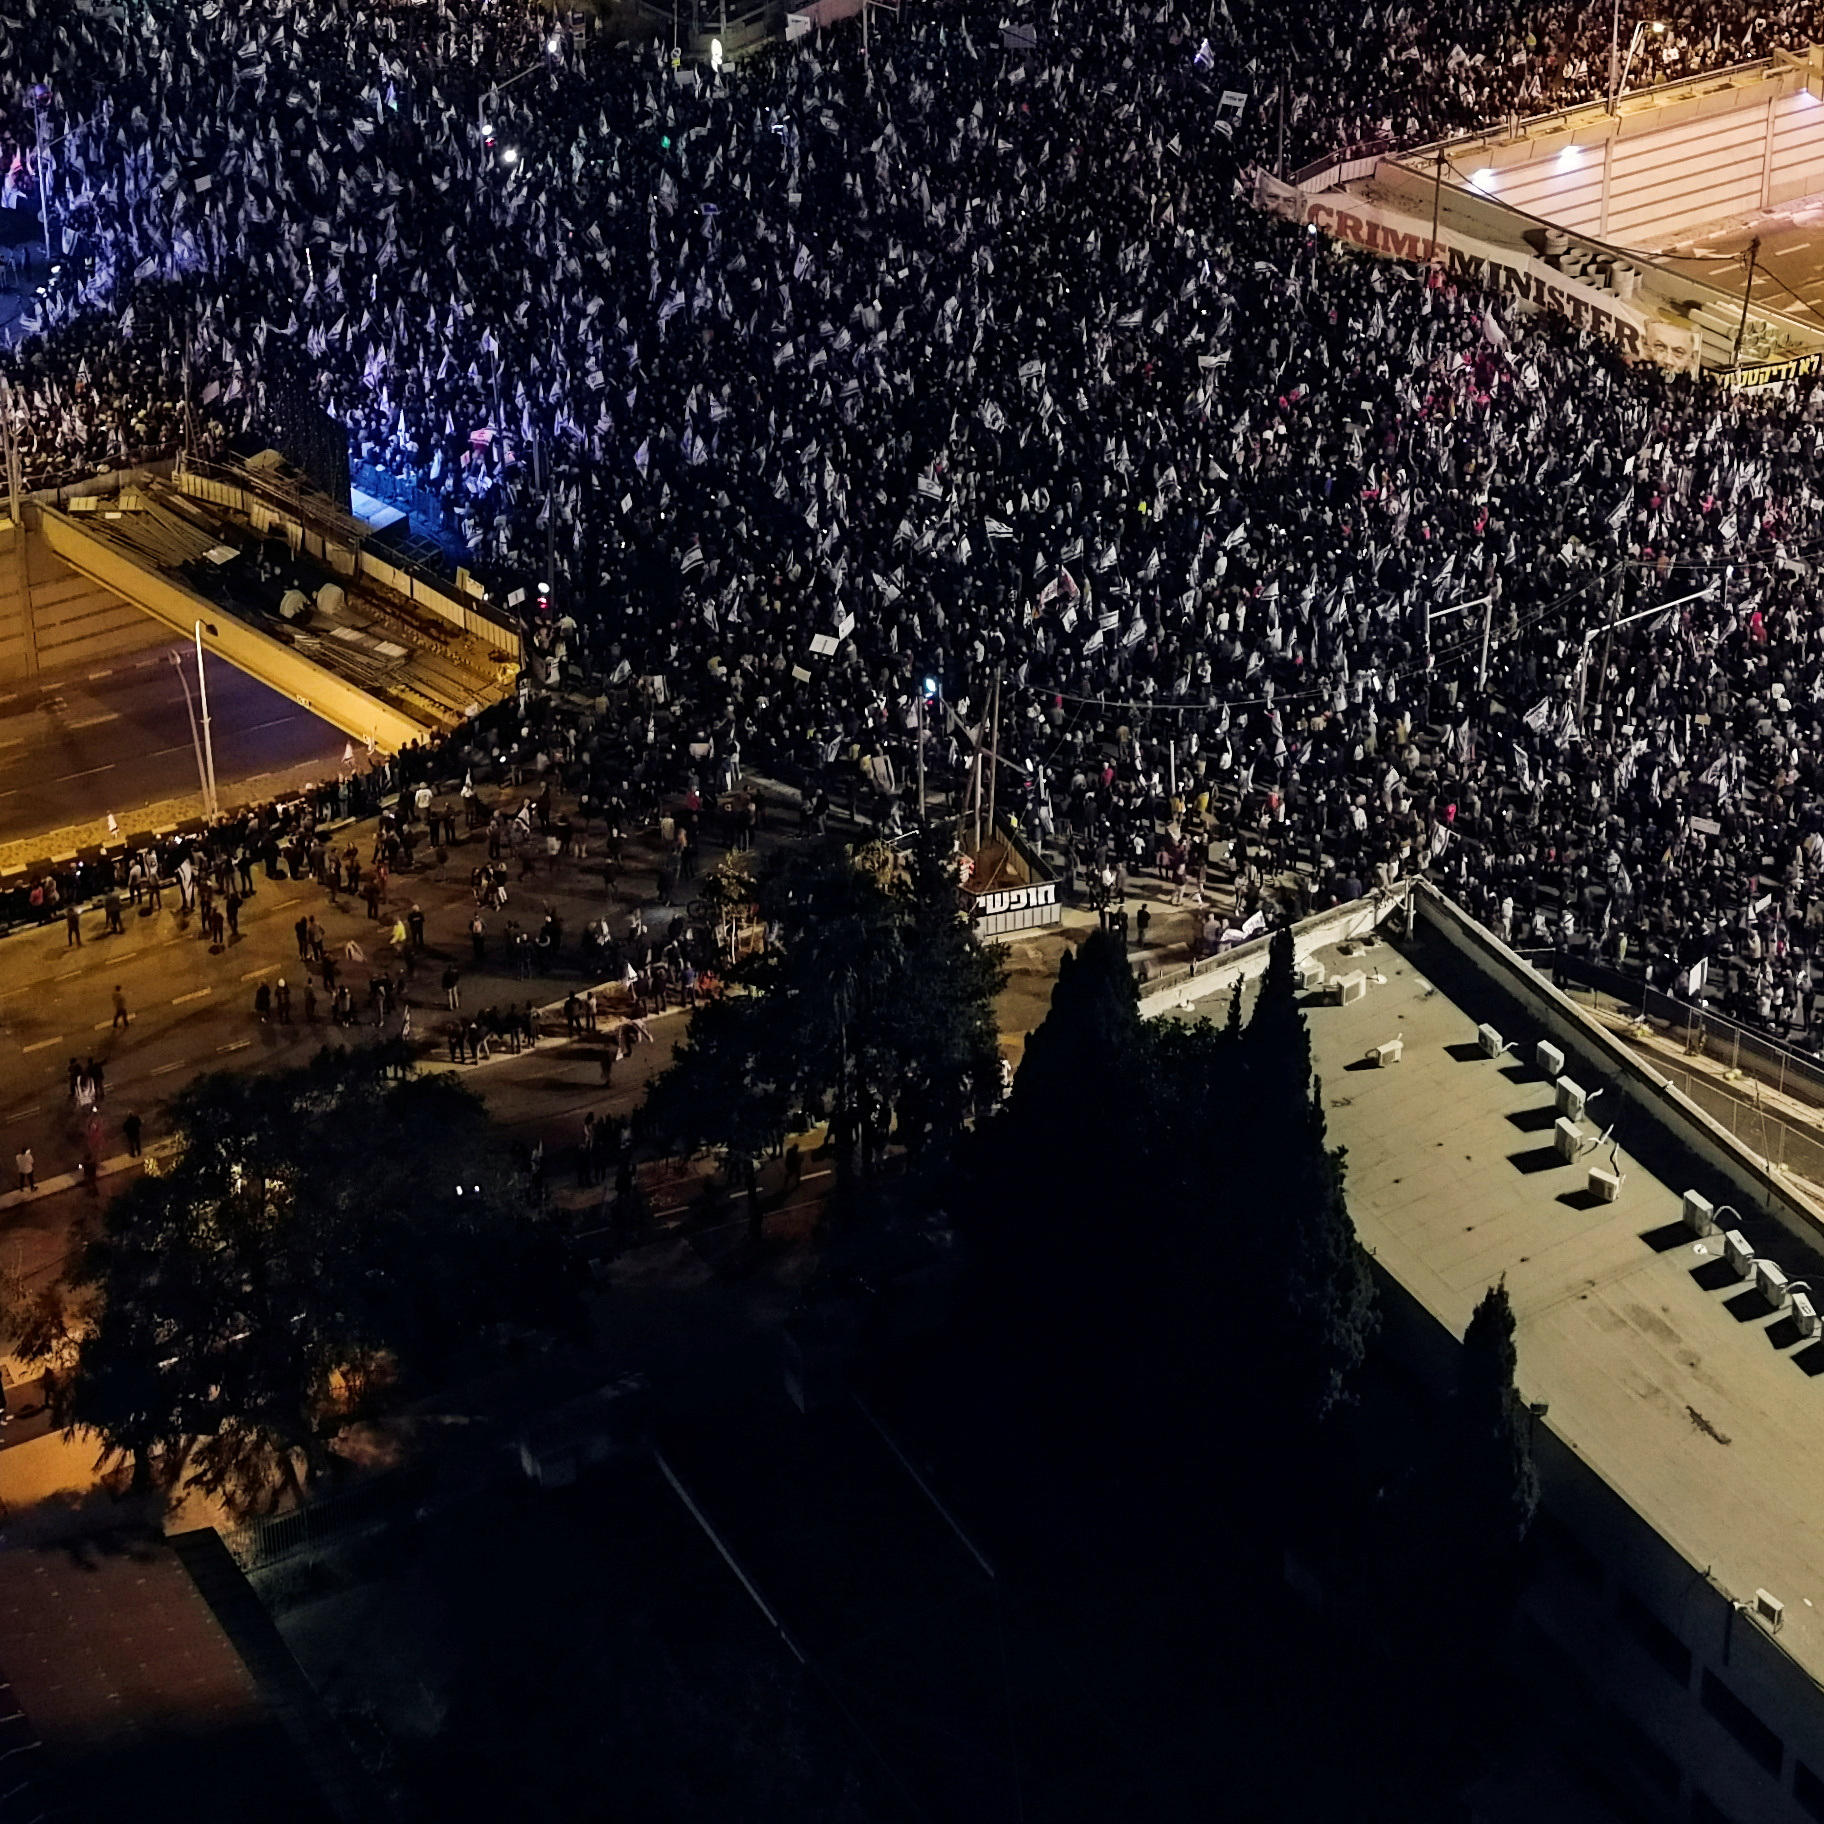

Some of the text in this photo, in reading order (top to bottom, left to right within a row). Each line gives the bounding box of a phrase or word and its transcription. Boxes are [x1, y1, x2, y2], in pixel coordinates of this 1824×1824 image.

[1307, 203, 1640, 355] CRIME MINISTER
[1798, 354, 1820, 376] לא
[976, 884, 1055, 914] חופשי
